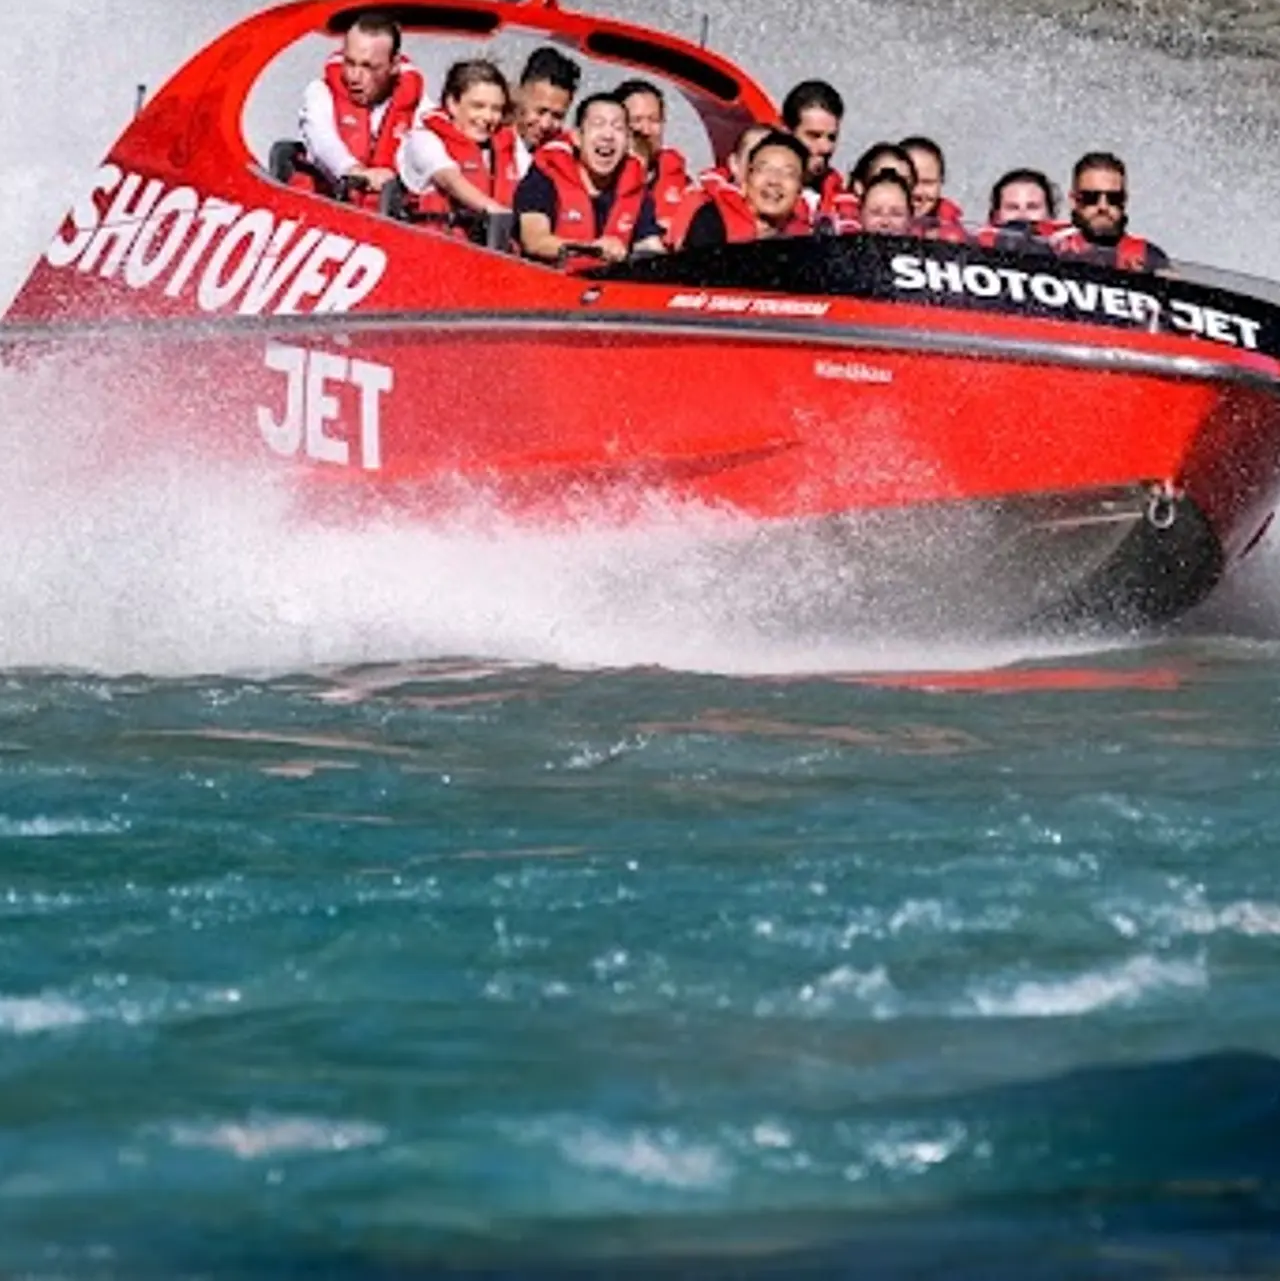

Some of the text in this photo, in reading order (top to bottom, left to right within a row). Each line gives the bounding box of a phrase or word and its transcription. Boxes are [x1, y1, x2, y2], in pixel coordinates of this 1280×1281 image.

[45, 163, 388, 317] SHOTOVER
[890, 255, 1261, 350] SHOTOVER JET
[256, 340, 395, 470] JET
